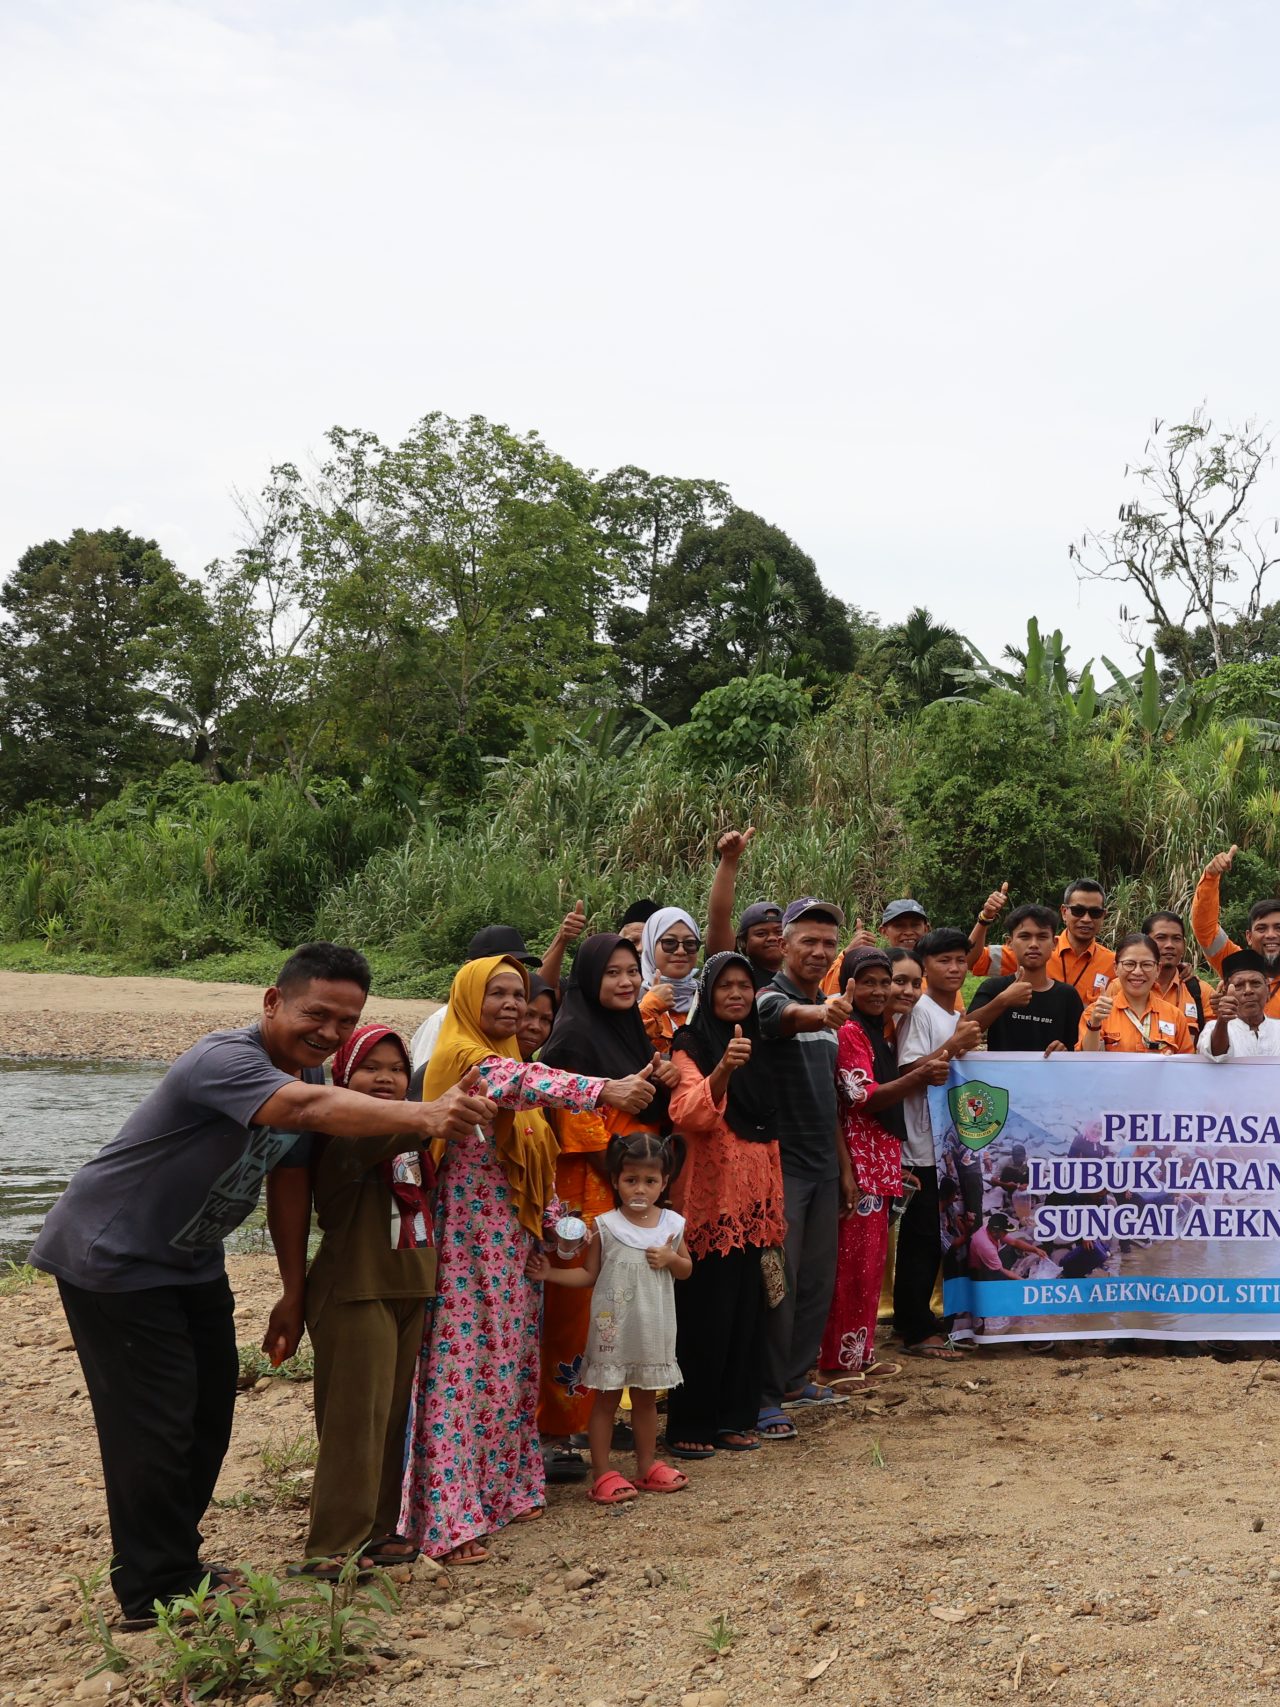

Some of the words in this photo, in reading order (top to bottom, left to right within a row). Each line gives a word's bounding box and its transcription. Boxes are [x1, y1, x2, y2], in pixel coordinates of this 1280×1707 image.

[1030, 1160, 1158, 1190] LUBUK
[1037, 1207, 1178, 1238] SUNGAI
[1023, 1285, 1082, 1304] DESA
[1089, 1283, 1230, 1303] AEKNGADOL
